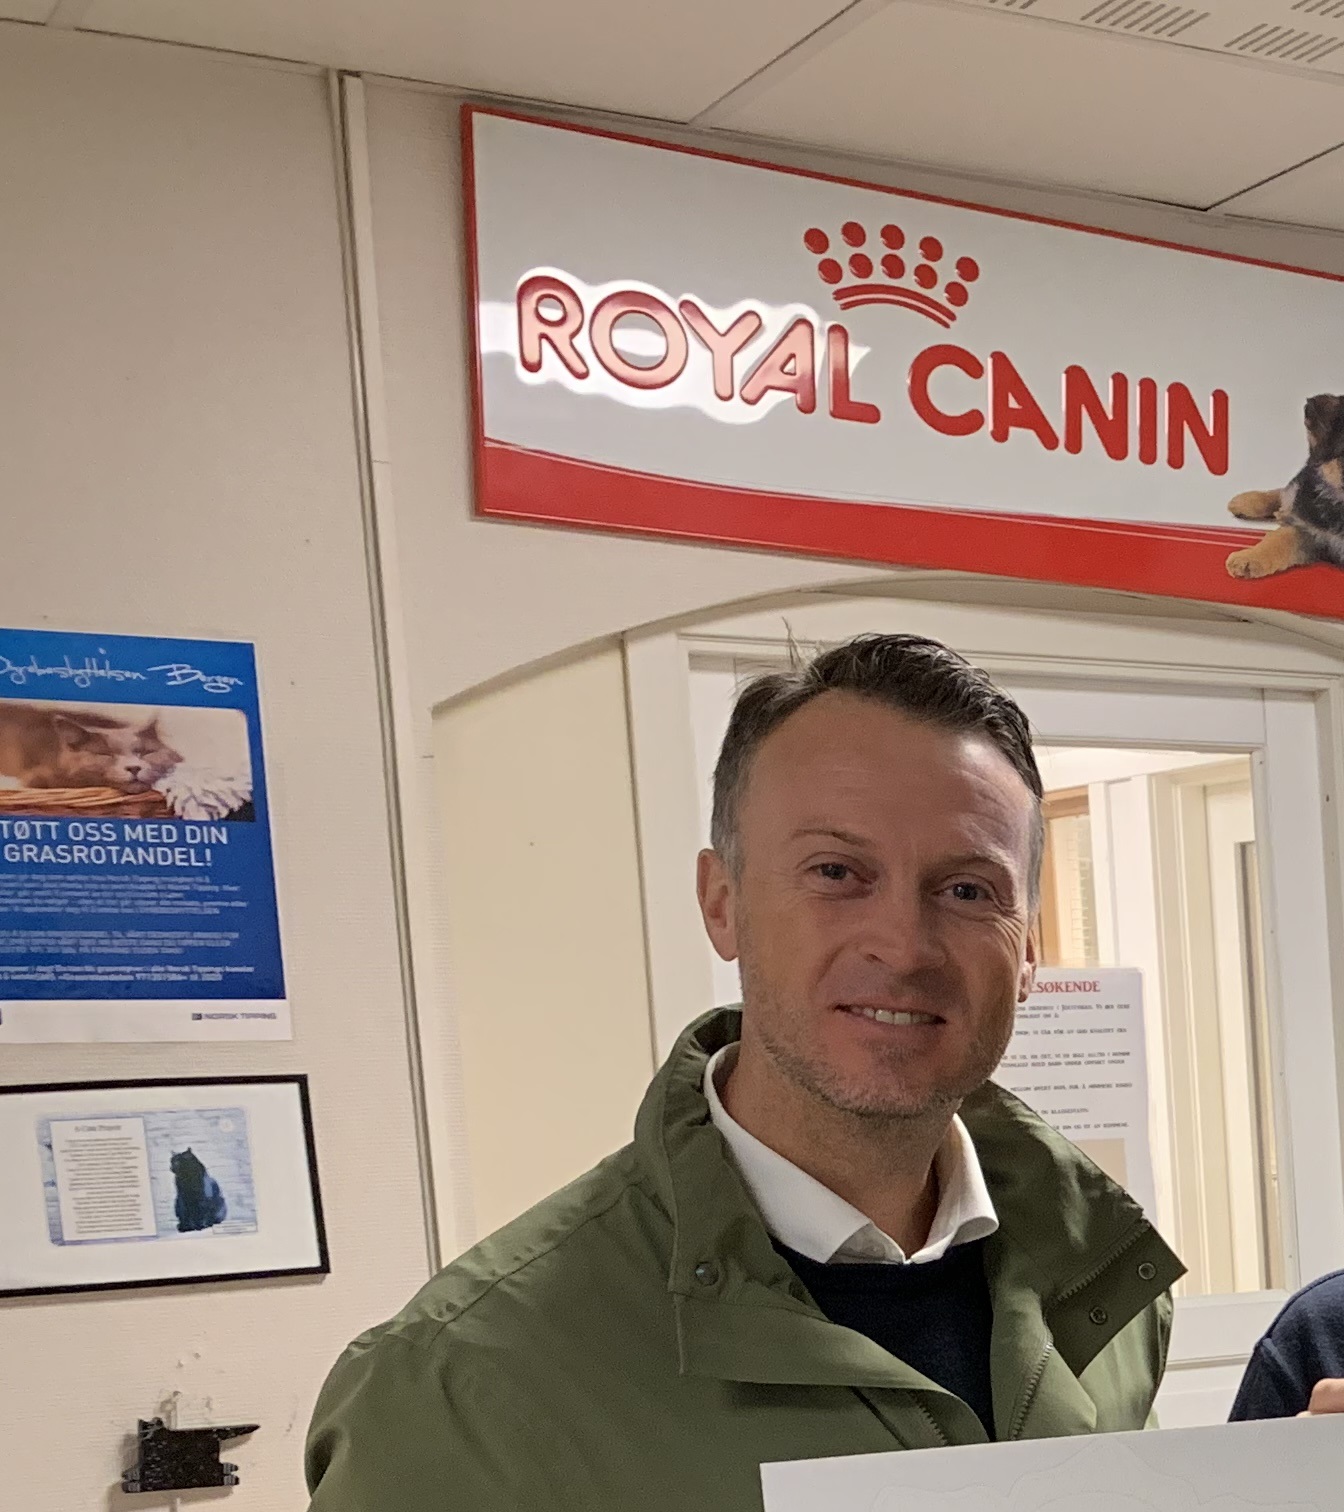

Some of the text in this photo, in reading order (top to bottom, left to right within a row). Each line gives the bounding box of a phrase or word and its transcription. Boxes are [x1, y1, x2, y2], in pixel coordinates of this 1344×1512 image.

[516, 274, 1230, 477] ROYAL CANIN
[0, 820, 228, 845] TØTT OSS MED DIN
[4, 844, 212, 867] GRASROTANDEL!
